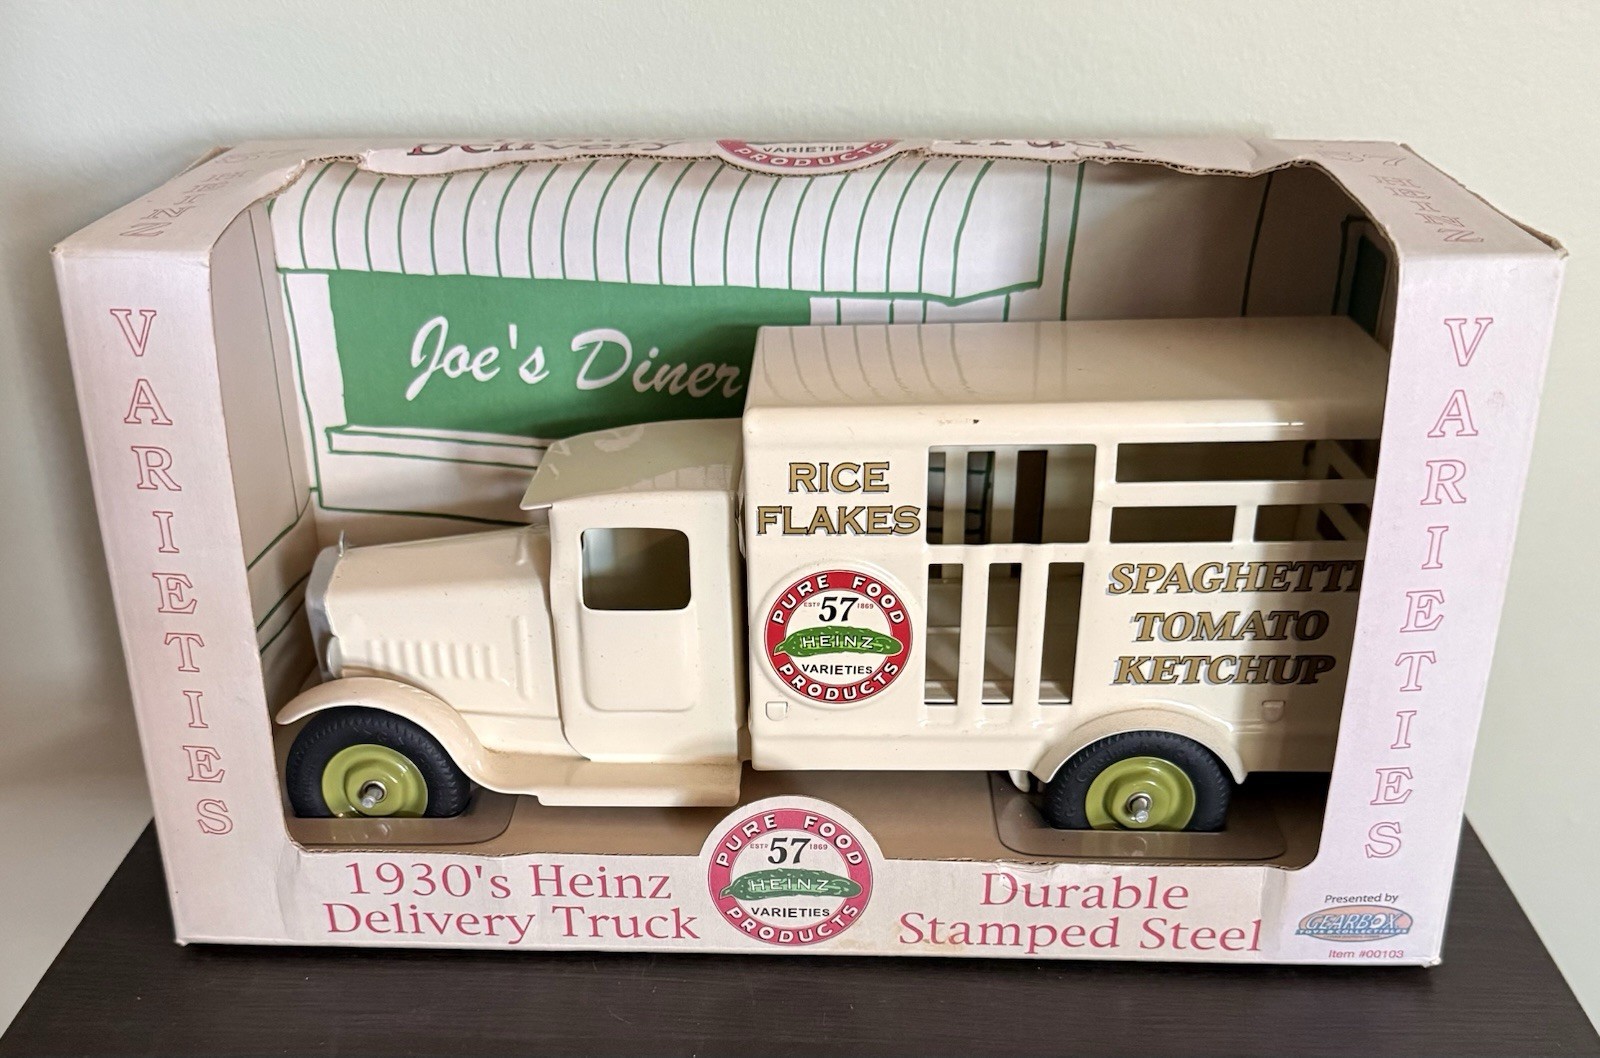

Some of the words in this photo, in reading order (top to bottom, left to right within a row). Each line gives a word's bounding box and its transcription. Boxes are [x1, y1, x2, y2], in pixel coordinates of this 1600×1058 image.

[734, 142, 888, 167] PRODUCTS
[762, 144, 855, 153] VARIETIES
[405, 316, 550, 401] Joe's
[571, 328, 743, 398] Diner
[788, 461, 890, 493] RICE
[756, 505, 921, 536] FLAKES
[110, 308, 234, 836] VARIETIES
[772, 574, 831, 626] PURE
[851, 575, 905, 624] FOOD
[1365, 317, 1494, 859] VARIETIES
[819, 596, 859, 622] 57
[857, 602, 874, 610] 1869
[1131, 609, 1330, 642] TOMATO
[802, 634, 874, 650] HEINZ
[778, 661, 899, 701] PRODUCTS
[801, 663, 873, 675] VARIETIES
[1109, 655, 1336, 686] KETCHUP
[716, 813, 777, 868] PURE
[803, 815, 863, 866] FOOD
[767, 837, 812, 865] 57
[345, 862, 511, 899] 1930's
[528, 864, 673, 900] Heinz
[751, 878, 829, 892] HEINZ
[979, 872, 1190, 910] Durable
[751, 907, 830, 918] VARIETIES
[1324, 893, 1382, 903] Presented
[1384, 893, 1399, 904] by
[323, 902, 536, 945] Delivery
[551, 905, 701, 940] Truck
[727, 905, 859, 943] PRODUCTS
[899, 912, 1120, 955] Stamped
[1139, 917, 1263, 952] Steel
[1305, 913, 1405, 930] GEARBOX
[1328, 949, 1355, 959] Item
[1359, 949, 1404, 958] #00103
